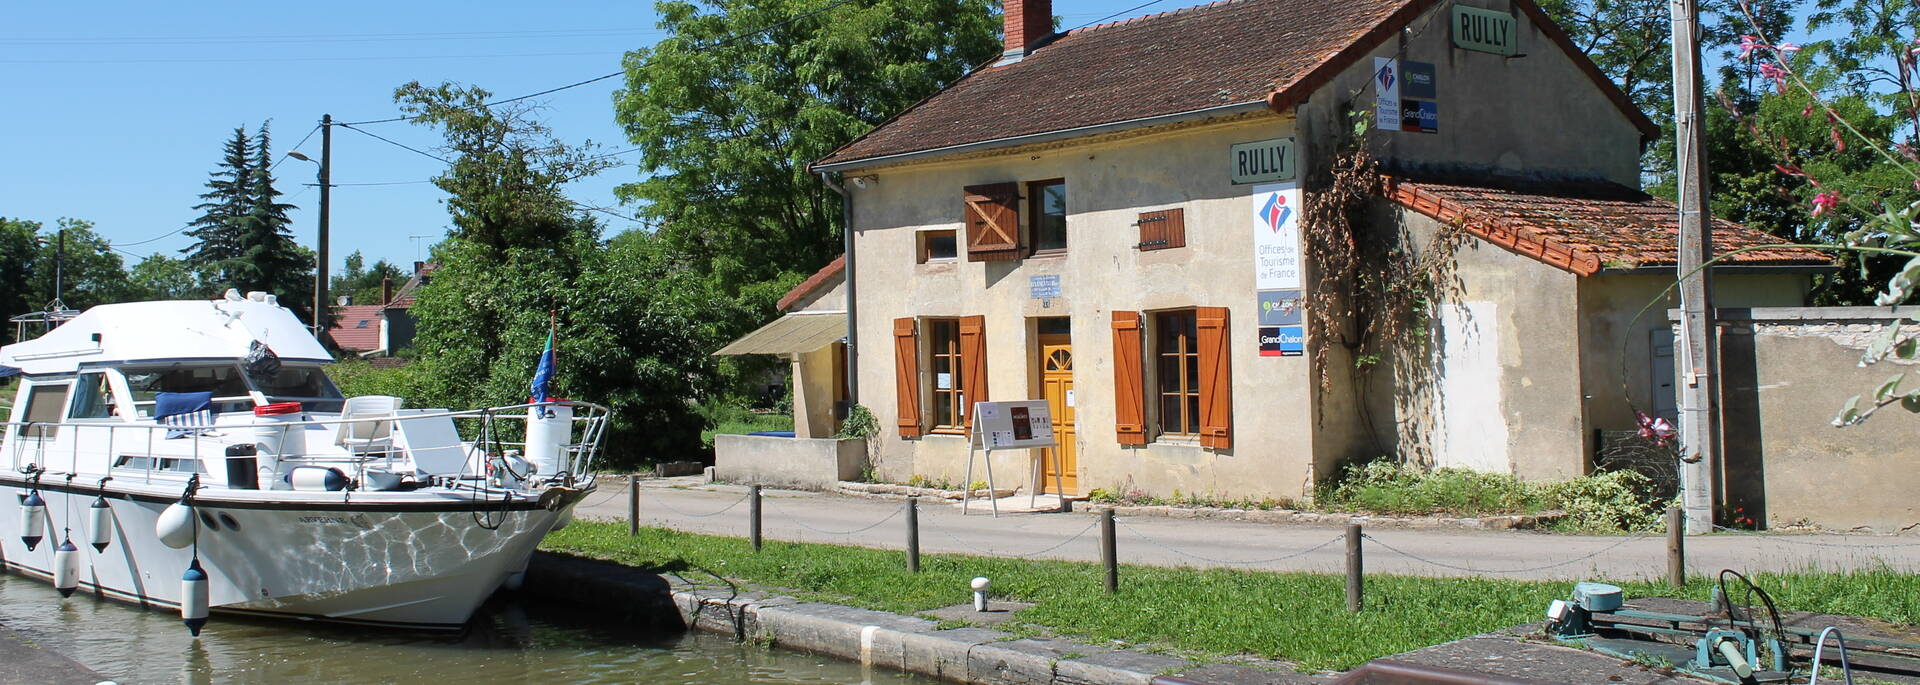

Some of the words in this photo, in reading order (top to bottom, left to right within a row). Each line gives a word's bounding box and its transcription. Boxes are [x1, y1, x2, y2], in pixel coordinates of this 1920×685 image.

[1461, 12, 1509, 47] RULLY
[1238, 145, 1286, 177] RULLY
[1258, 244, 1285, 255] Offices
[1259, 256, 1295, 267] Tourisme
[1269, 268, 1296, 278] France
